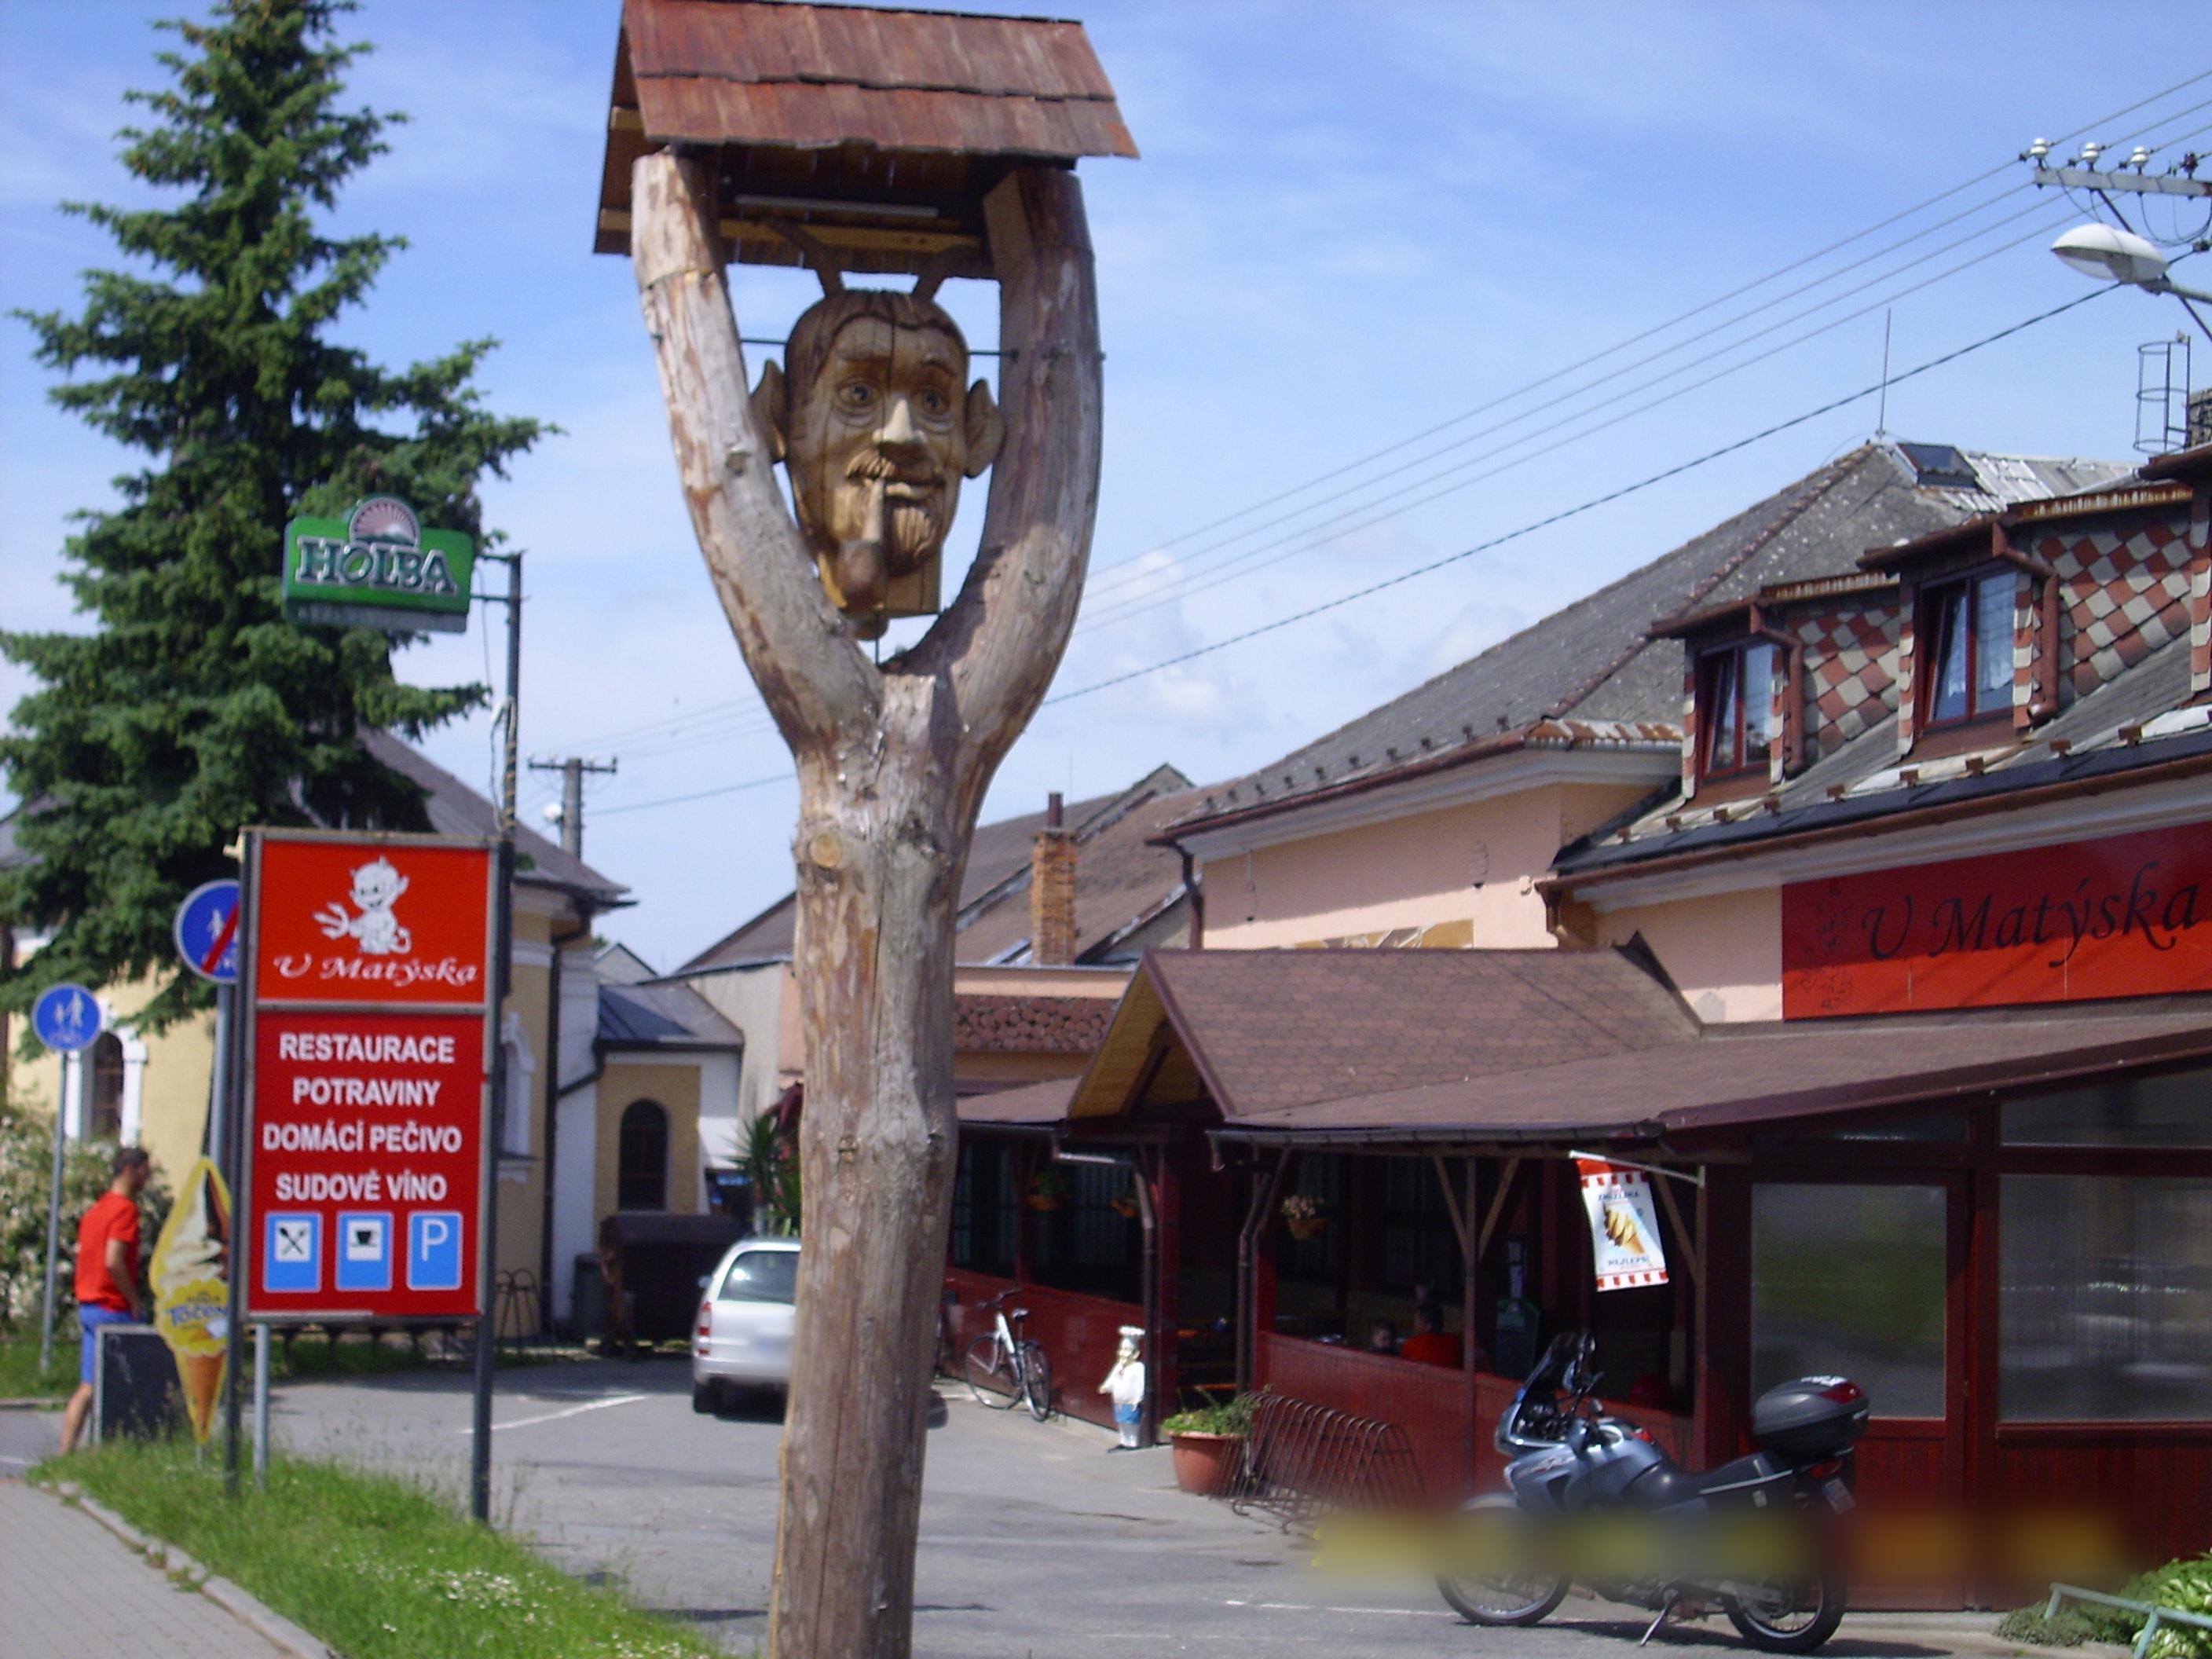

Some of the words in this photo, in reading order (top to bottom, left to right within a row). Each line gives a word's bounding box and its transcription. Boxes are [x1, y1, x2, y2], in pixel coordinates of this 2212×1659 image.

[295, 536, 458, 595] HOLBA
[1861, 894, 1913, 961] U
[1928, 861, 2200, 968] Matýska
[273, 953, 312, 979] U
[320, 956, 478, 987] Matýska
[279, 1032, 456, 1064] RESTAURACE
[293, 1077, 441, 1106] POTRAVINY
[262, 1119, 364, 1152] DOMÁCÍ
[370, 1121, 463, 1152] PEČIVO
[276, 1169, 381, 1201] SUDOVÉ
[387, 1169, 448, 1201] VÍNO
[422, 1219, 449, 1262] P
